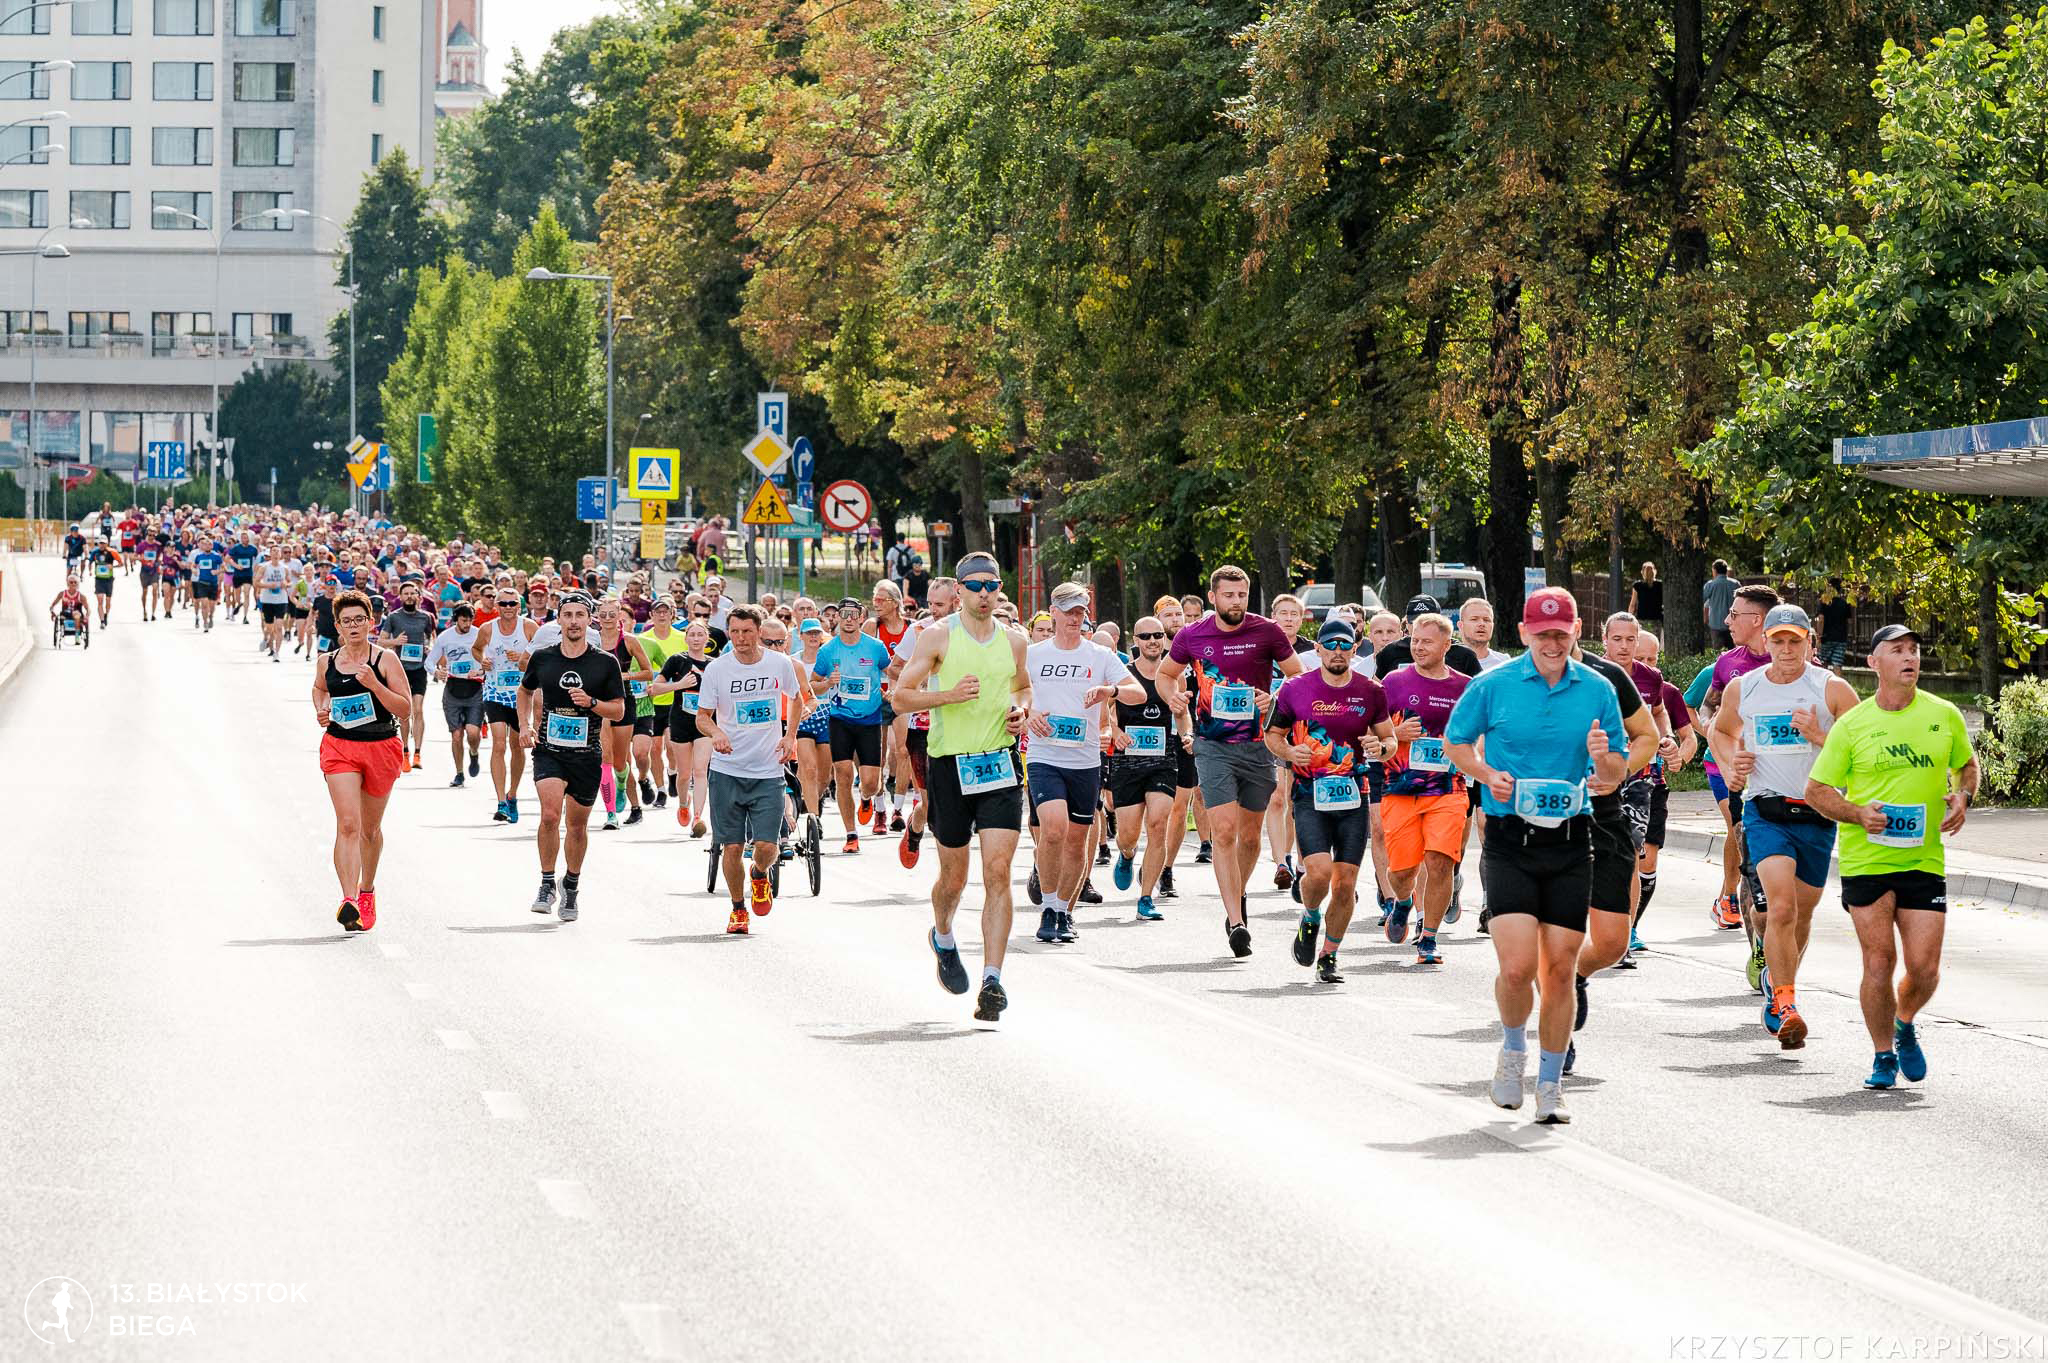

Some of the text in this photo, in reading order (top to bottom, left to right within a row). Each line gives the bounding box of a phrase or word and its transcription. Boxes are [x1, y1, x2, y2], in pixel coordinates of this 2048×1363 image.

[1223, 643, 1257, 651] Mercedes-Benz
[1040, 664, 1082, 678] BGT
[505, 676, 520, 684] 672
[730, 676, 769, 694] BGT
[1225, 697, 1248, 708] 186
[341, 703, 366, 717] 644
[748, 707, 771, 719] 453
[558, 724, 581, 736] 478
[1057, 725, 1081, 736] 520
[1770, 725, 1801, 739] 594
[1137, 735, 1159, 745] 105
[975, 763, 1002, 778] 341
[1328, 785, 1352, 797] 200
[1536, 793, 1572, 809] 389
[1886, 816, 1917, 831] 206
